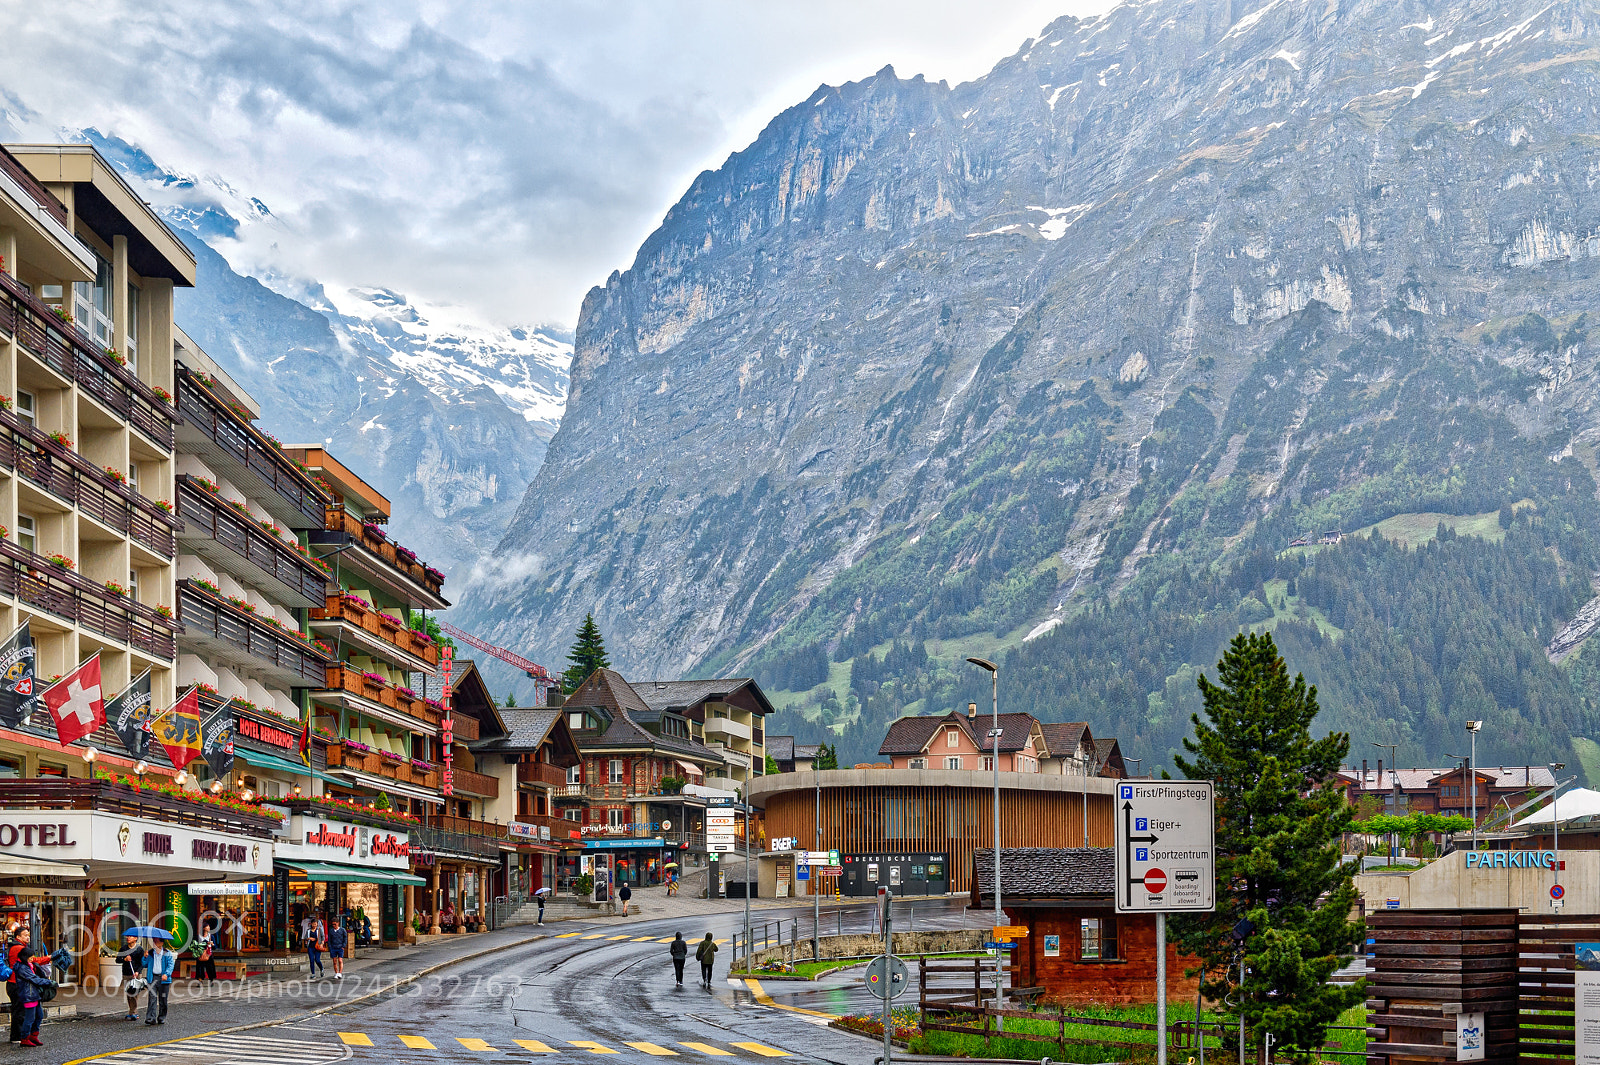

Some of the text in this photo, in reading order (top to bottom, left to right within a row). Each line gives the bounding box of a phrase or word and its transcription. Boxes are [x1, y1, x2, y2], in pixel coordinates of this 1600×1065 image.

[121, 691, 141, 708] HOTEL
[118, 703, 137, 724] KREUZ
[441, 646, 454, 796] HOTEL WOLTER
[239, 717, 294, 750] HOTEL BERNERHOF
[1135, 787, 1207, 801] First/Pfingstegg
[0, 823, 77, 847] OTEL
[1150, 819, 1182, 831] Eiger+
[143, 831, 174, 855] HOTEL
[320, 823, 358, 855] Bernerhof
[192, 838, 247, 863] KREUZ & POST
[1150, 849, 1209, 861] Sportzentrum
[1466, 851, 1556, 868] PARKING
